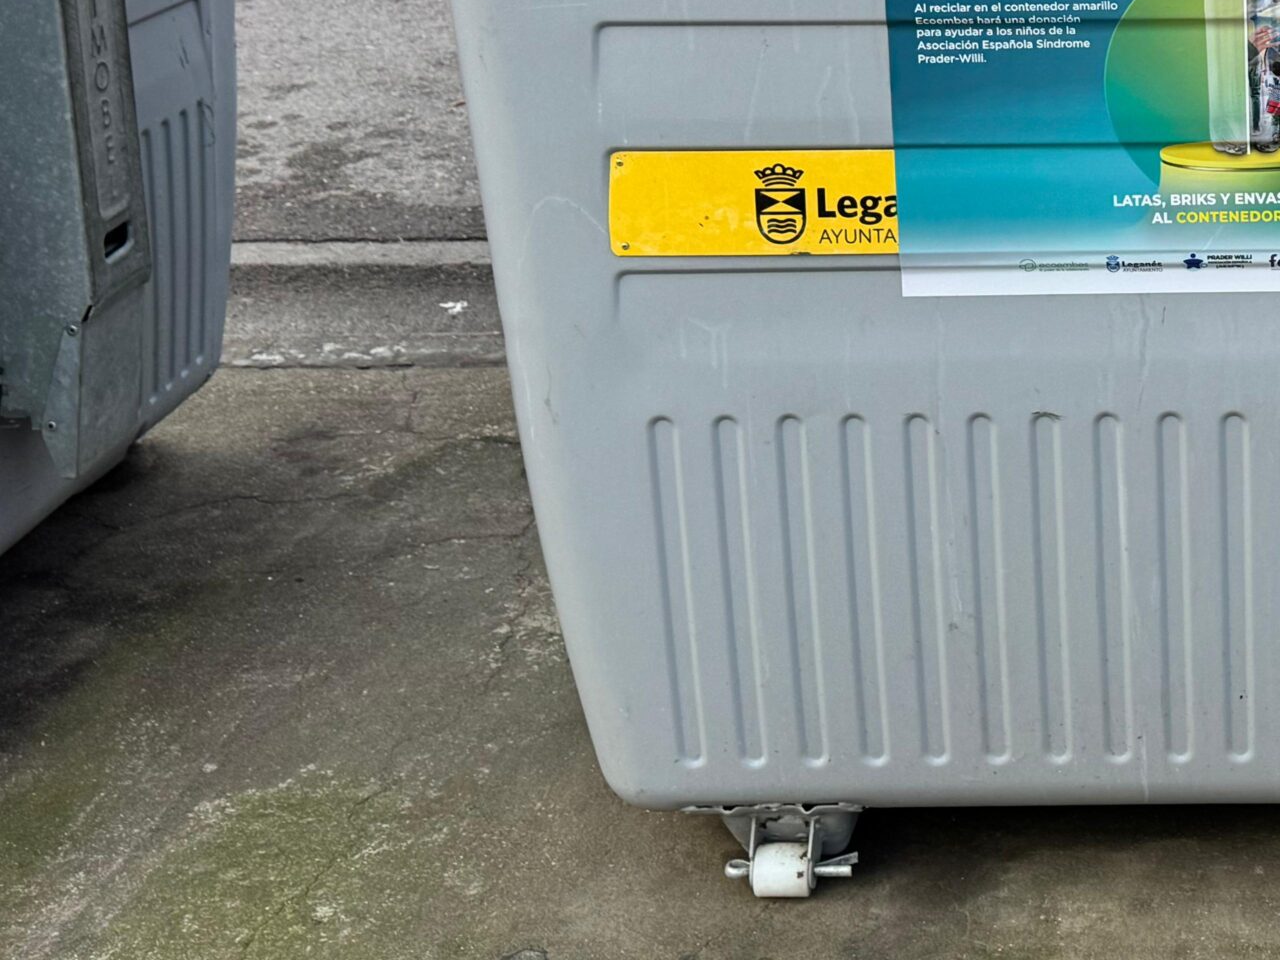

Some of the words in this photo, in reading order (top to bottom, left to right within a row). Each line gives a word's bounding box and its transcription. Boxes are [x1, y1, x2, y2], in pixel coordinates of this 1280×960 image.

[914, 2, 927, 13] Al
[929, 2, 972, 13] reciclar
[974, 4, 989, 13] en
[991, 1, 1002, 13] el
[1005, 1, 1070, 12] contenedor
[1072, 0, 1118, 11] amarillo
[915, 16, 974, 25] Ecoembes
[977, 15, 1002, 25] hará
[1005, 16, 1025, 24] una
[1028, 14, 1081, 24] donación
[916, 27, 942, 38] para
[945, 26, 983, 38] ayudar
[986, 28, 994, 37] a
[996, 26, 1013, 36] los
[1015, 26, 1046, 36] niños
[1048, 26, 1063, 36] de
[1066, 26, 1076, 35] la
[917, 39, 979, 51] Asociación
[982, 39, 1034, 51] Española
[1036, 38, 1091, 49] Síndrome
[917, 52, 987, 64] Prader-Willi.
[1112, 193, 1166, 209] LATAS,
[1170, 192, 1216, 206] BRIKS
[1219, 192, 1231, 205] Y
[1152, 211, 1173, 224] AL
[818, 227, 898, 245] AYUNTA
[1121, 260, 1163, 269] Leganés
